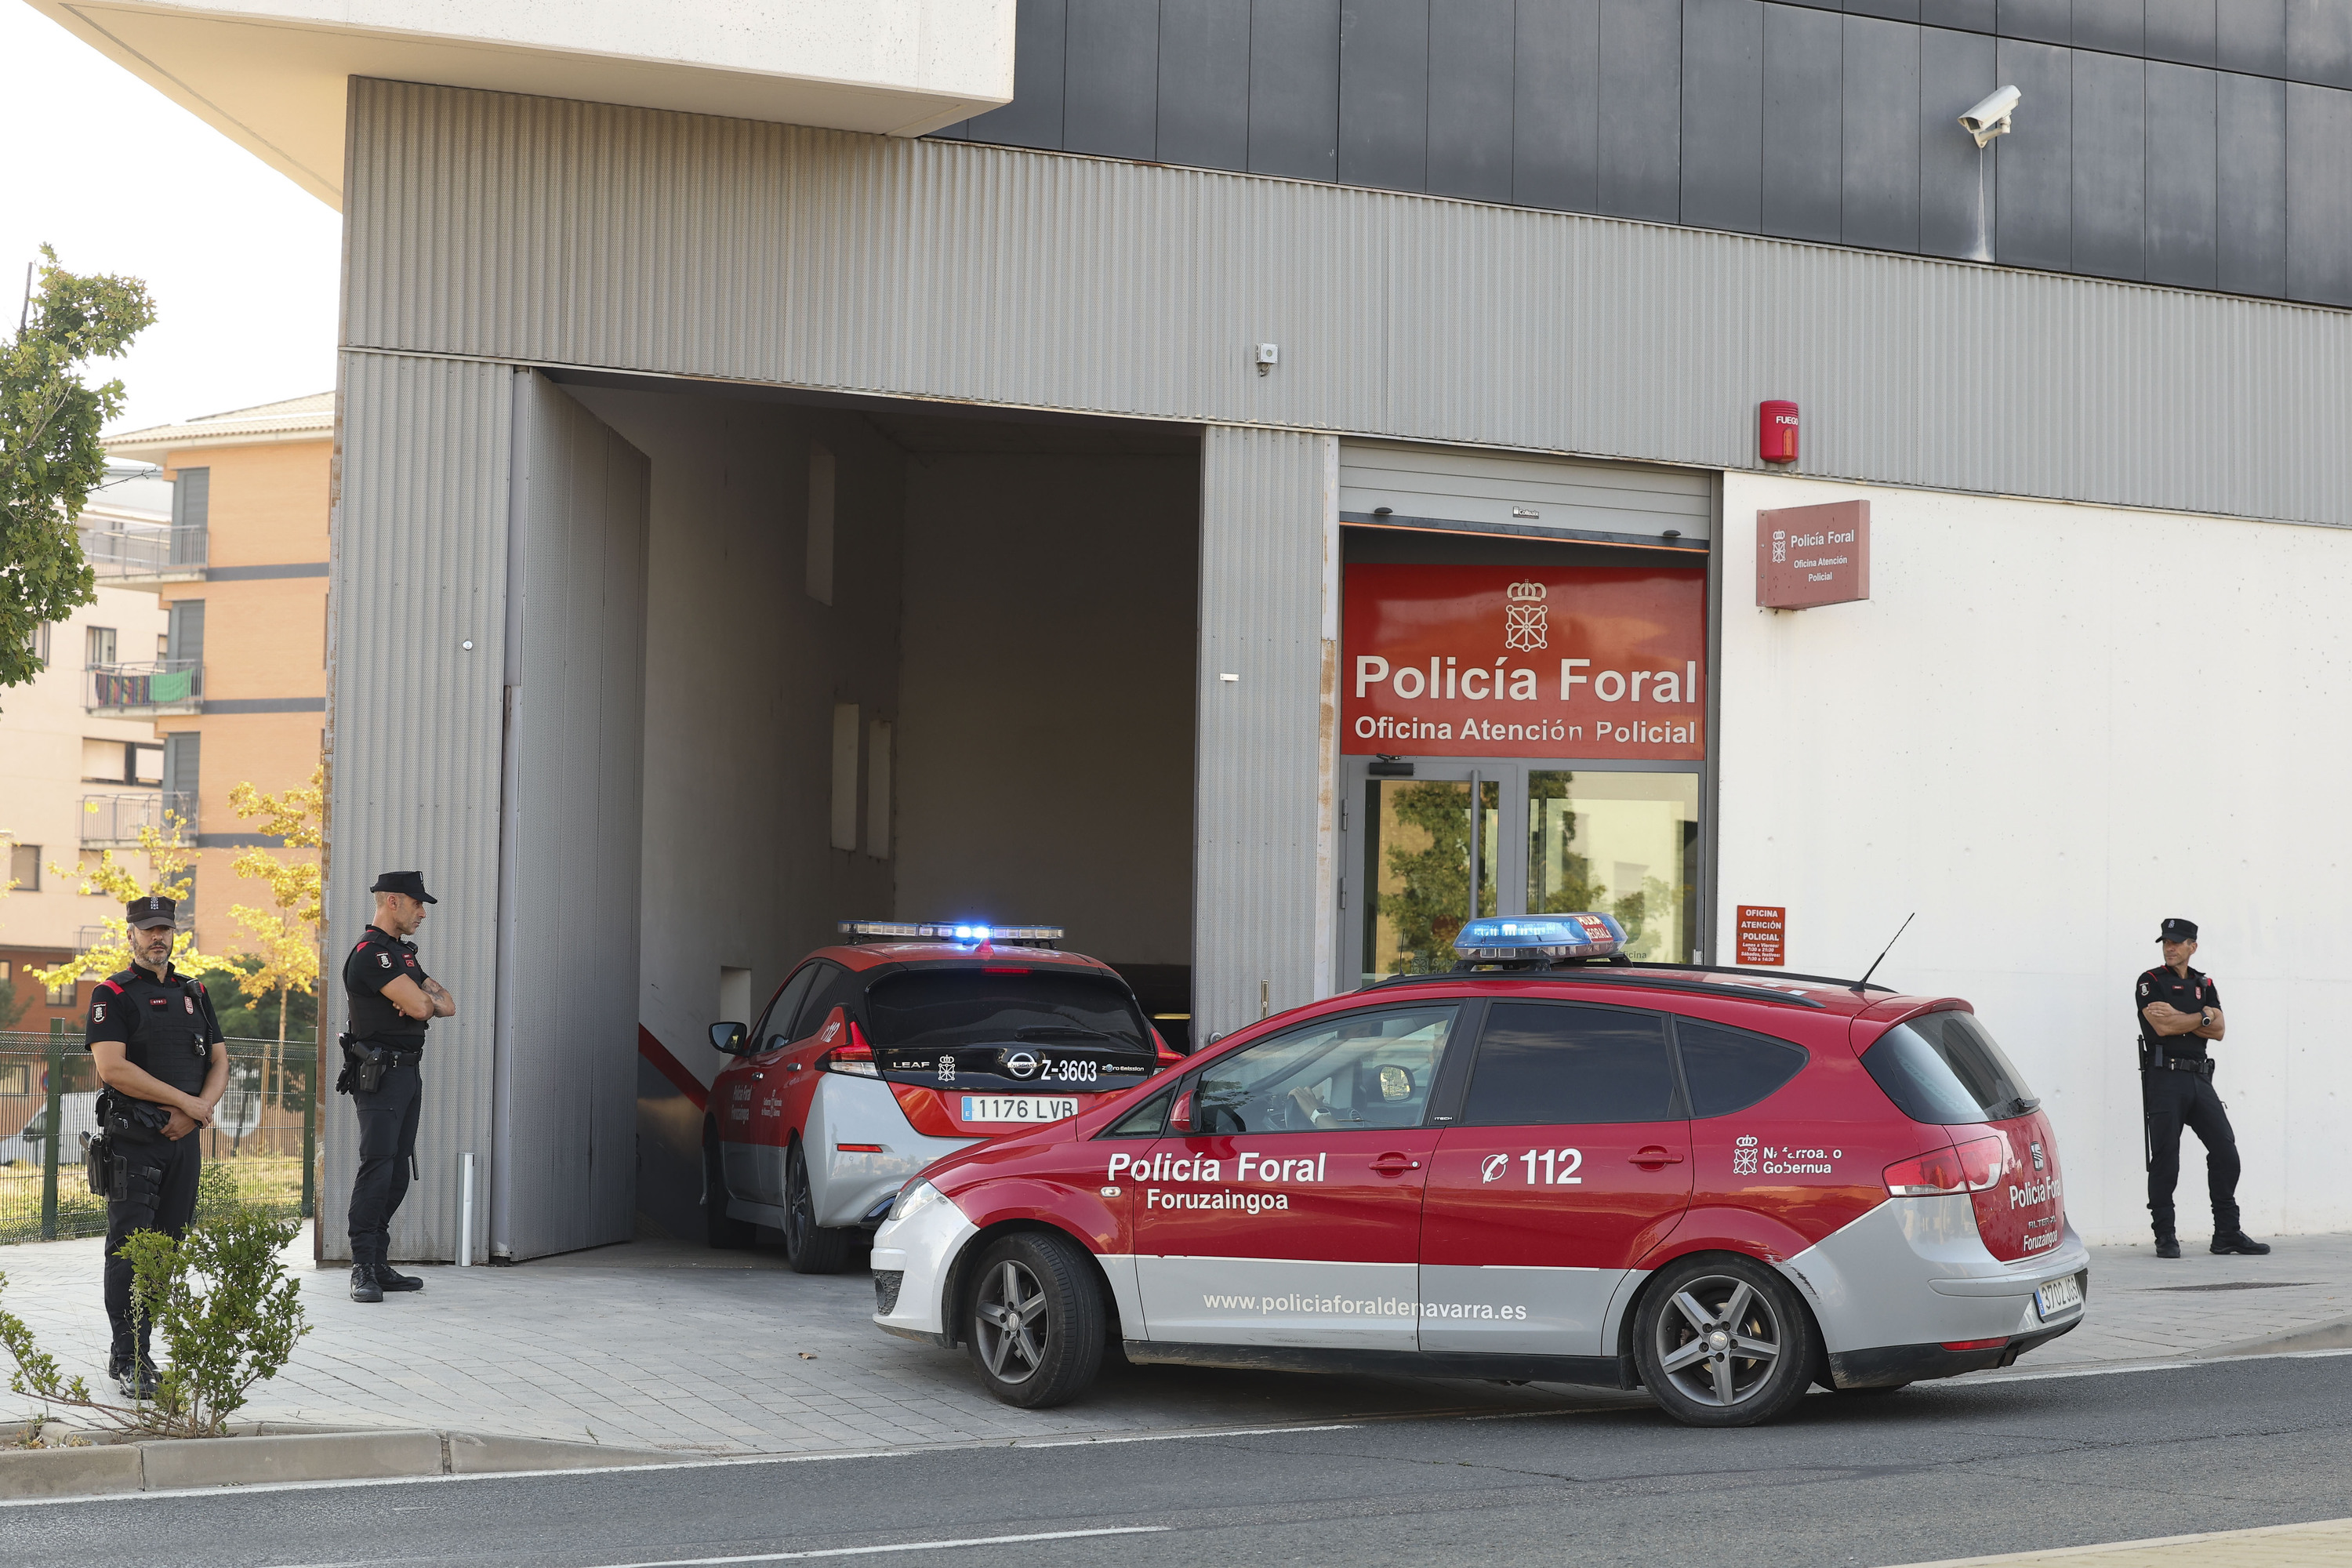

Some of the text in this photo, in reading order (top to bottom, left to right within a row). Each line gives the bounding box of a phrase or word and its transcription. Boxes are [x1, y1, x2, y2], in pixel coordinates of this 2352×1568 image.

[1776, 416, 1798, 426] FUEGO
[1791, 529, 1855, 548] Policía Foral
[1794, 555, 1848, 568] Oficina Atención
[1808, 572, 1833, 582] Policial
[1356, 655, 1696, 703] Policía Foral
[1355, 716, 1696, 744] Oficina Atención Policial
[1745, 909, 1778, 918] OFICINA
[1740, 920, 1781, 930] ATENCIÓN
[1743, 932, 1780, 942] POLICIAL
[1040, 1059, 1097, 1082] Z-3603
[979, 1099, 1029, 1118] 1176
[1107, 1152, 1327, 1182] Policía Foral
[1519, 1148, 1583, 1185] 112
[1763, 1161, 1831, 1174] Gobernua
[1147, 1189, 1289, 1215] Foruzaingoa
[2009, 1178, 2046, 1210] Policía
[2024, 1229, 2058, 1251] Foruzaingoa
[1203, 1293, 1527, 1320] www.policiaforaldenavarra.es
[2042, 1281, 2067, 1310] 3702
